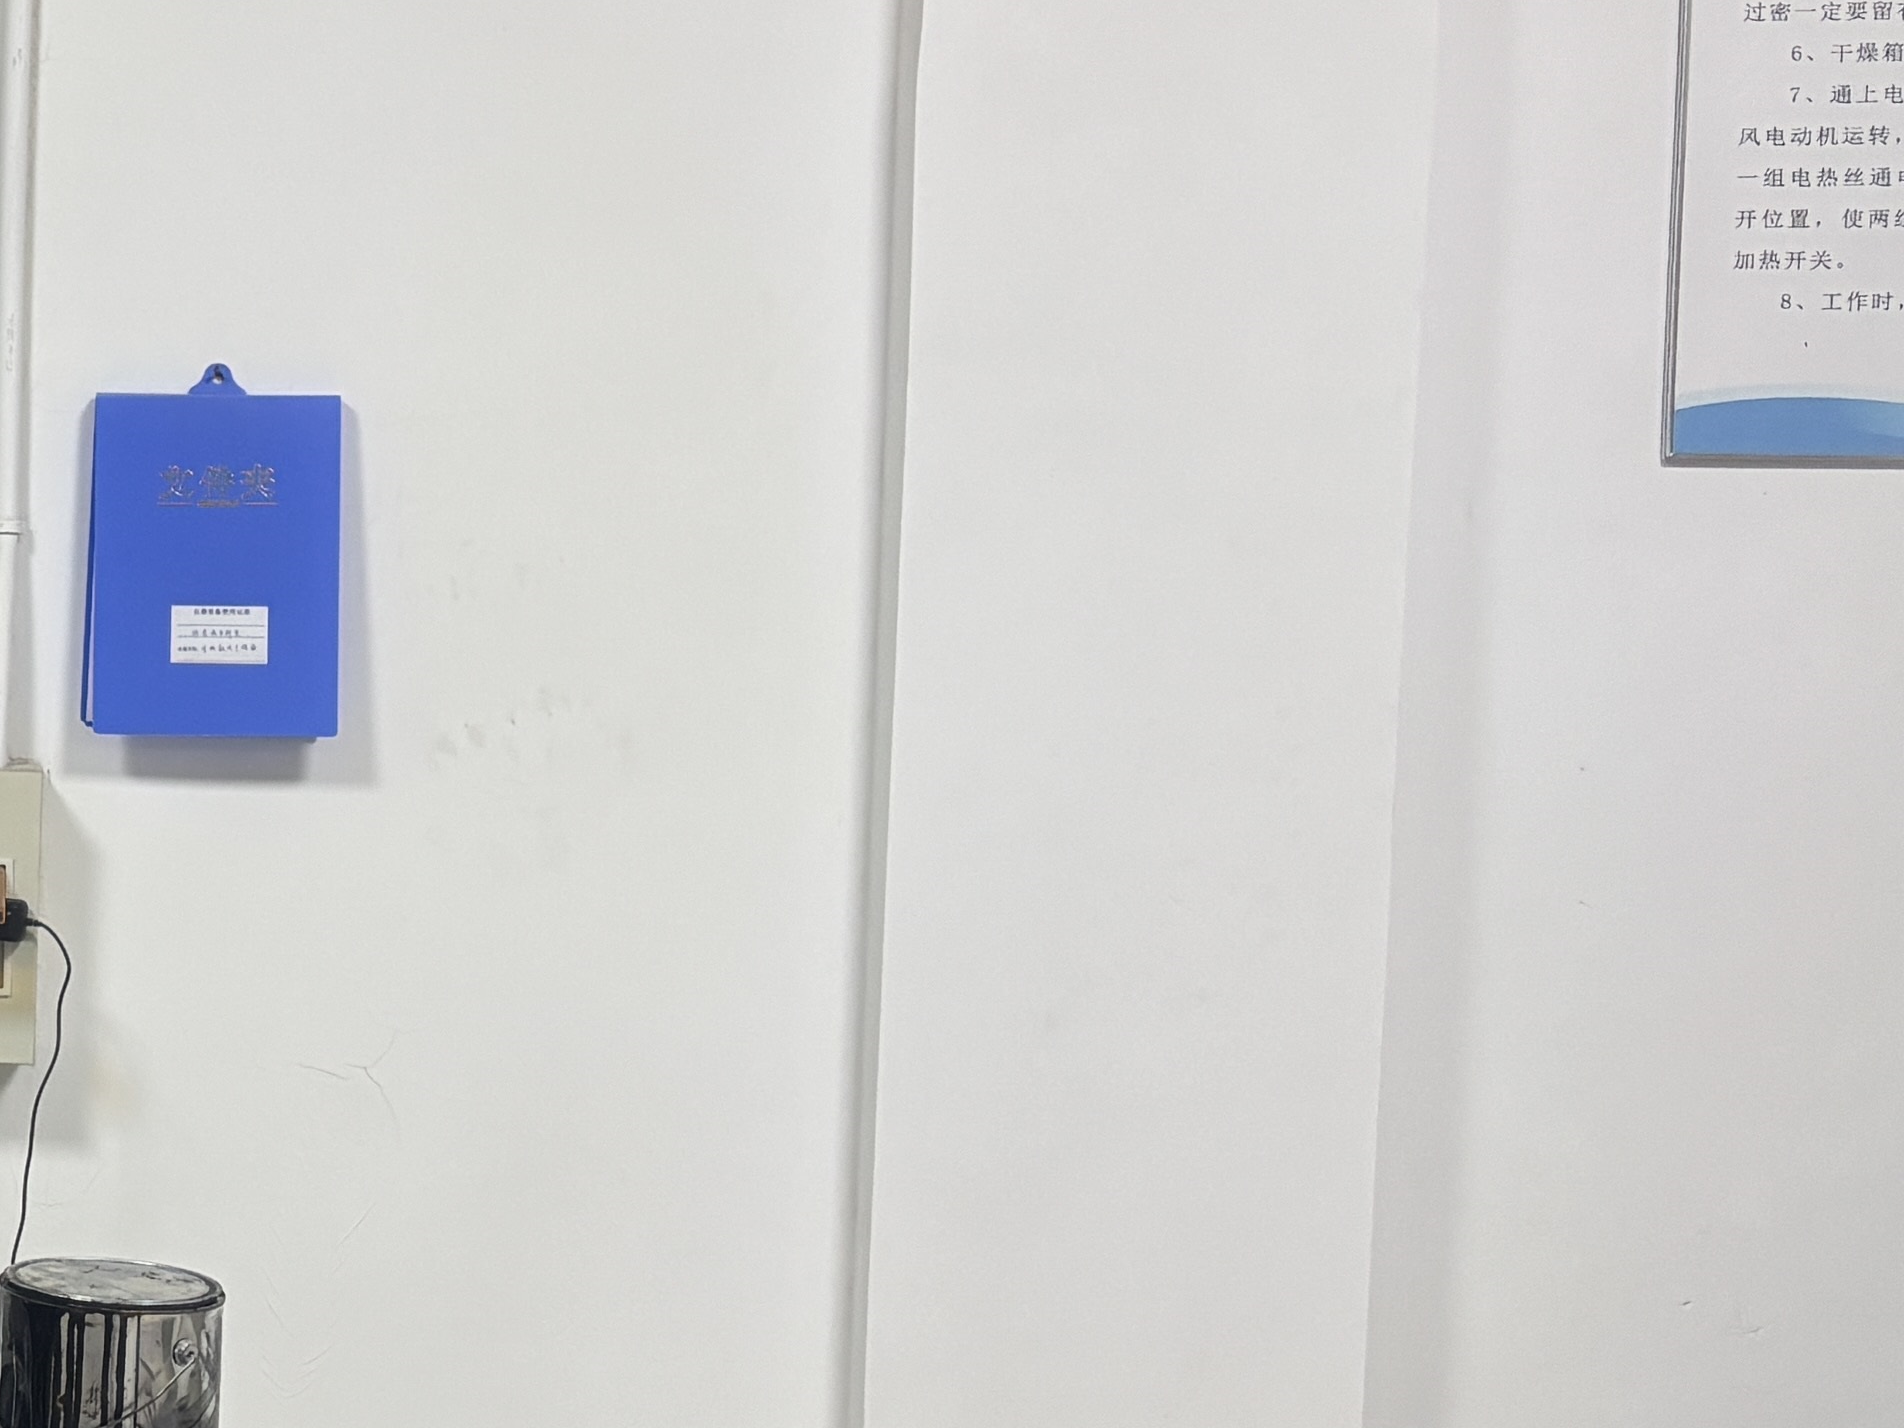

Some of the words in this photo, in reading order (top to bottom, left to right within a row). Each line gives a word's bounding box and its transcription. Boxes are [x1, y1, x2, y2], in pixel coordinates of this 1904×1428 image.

[1791, 42, 1904, 63] 6、干燥箱
[1789, 83, 1904, 105] 7、通上电
[1738, 125, 1902, 147] 风电动机运转，
[1733, 249, 1845, 271] 加热开关。
[1780, 291, 1904, 313] 8、工作时，
